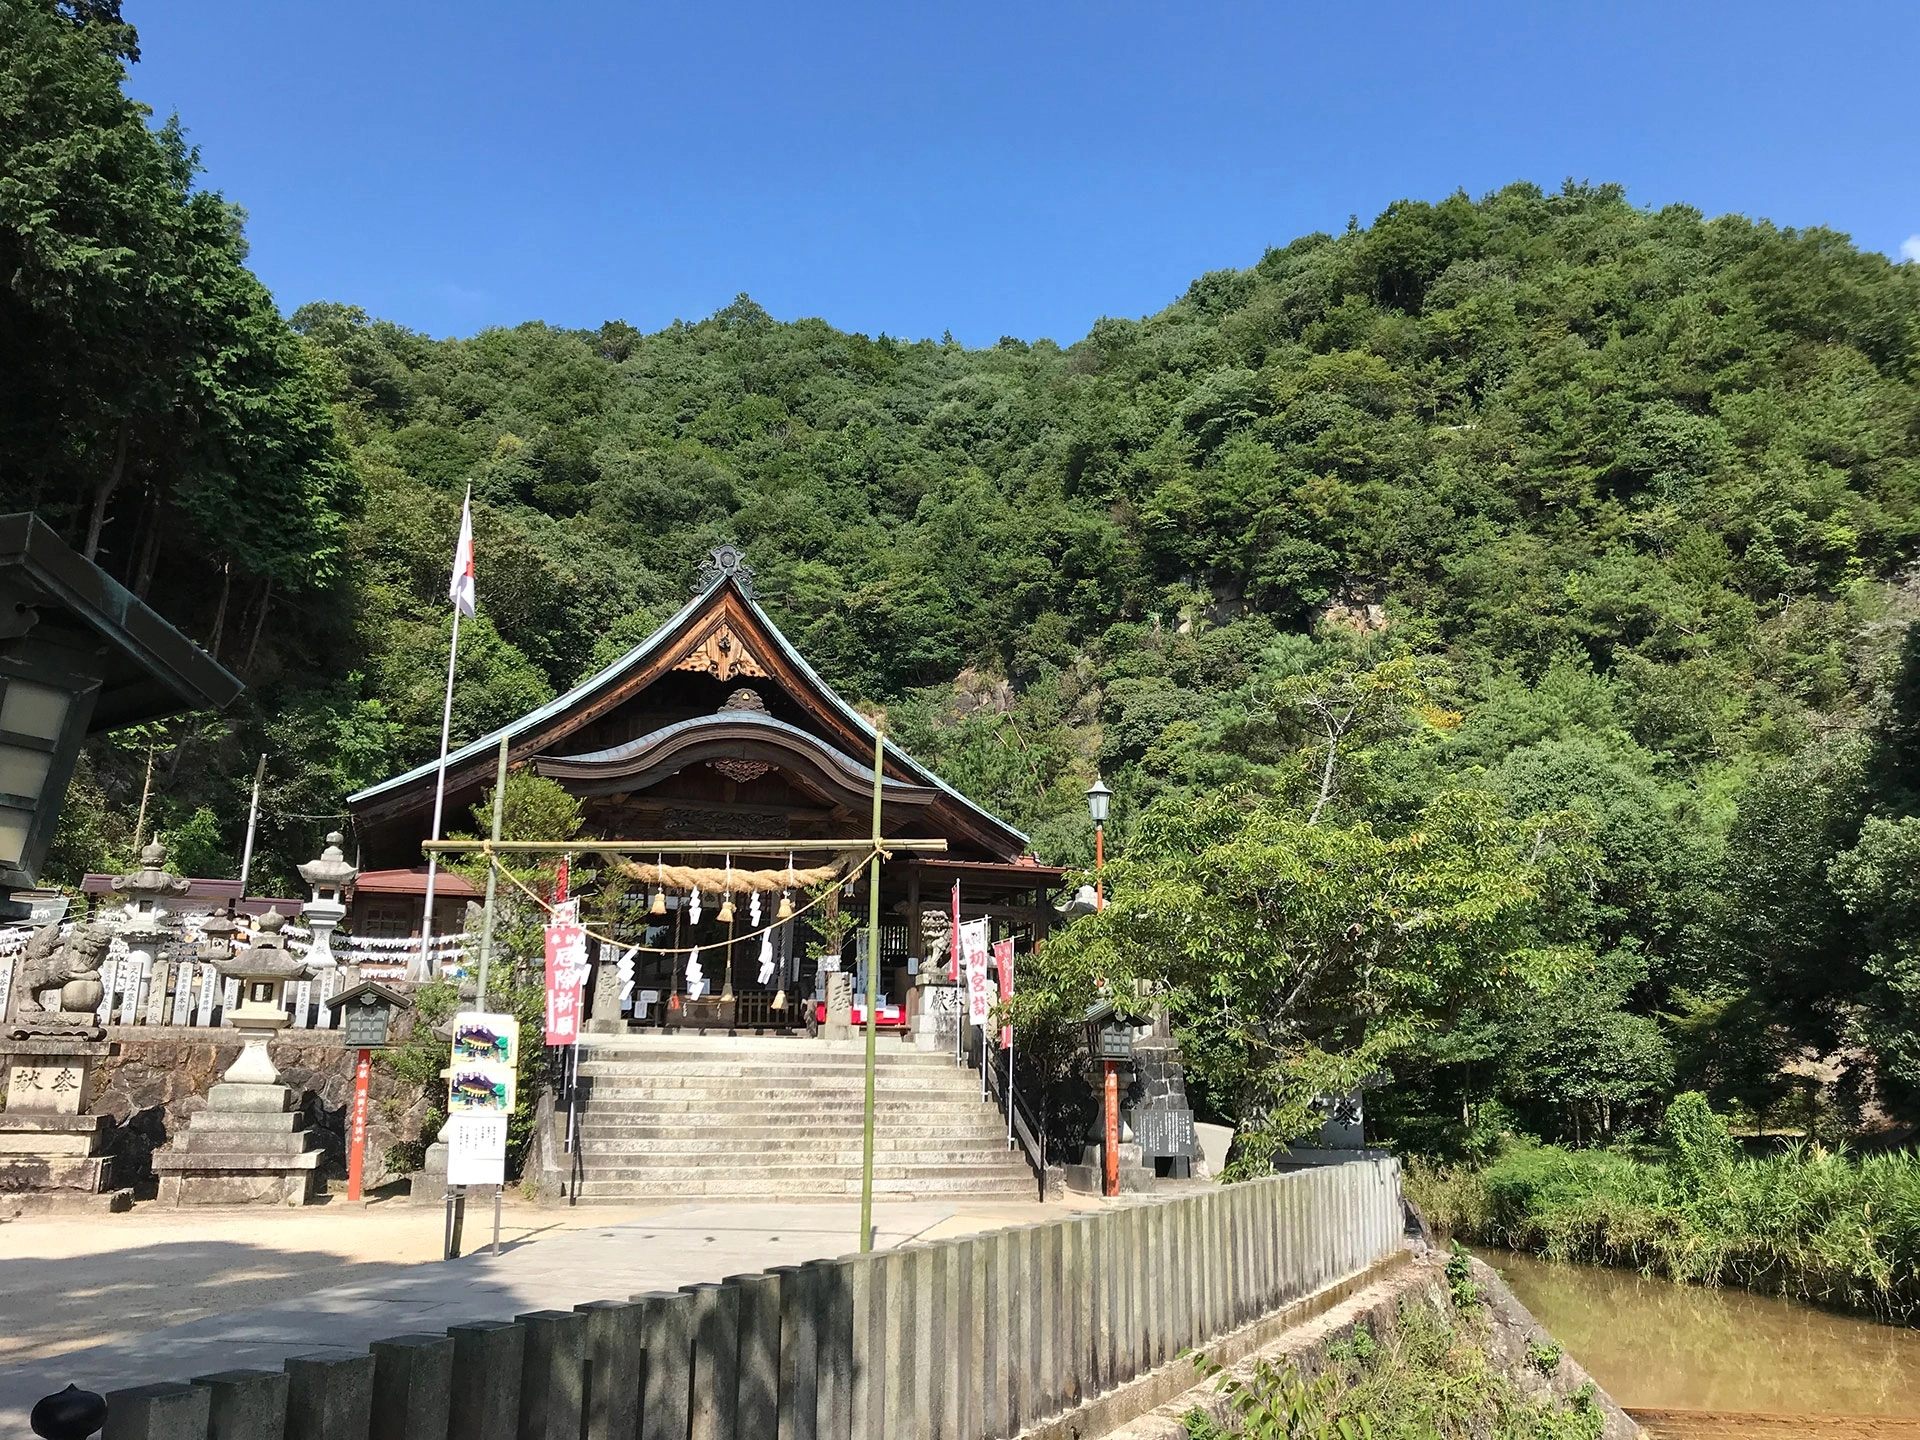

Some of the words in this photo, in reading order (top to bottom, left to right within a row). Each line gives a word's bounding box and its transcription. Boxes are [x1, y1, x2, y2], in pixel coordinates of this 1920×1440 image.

[552, 947, 577, 1036] 厄除祈願
[970, 951, 985, 1016] 初宮詣
